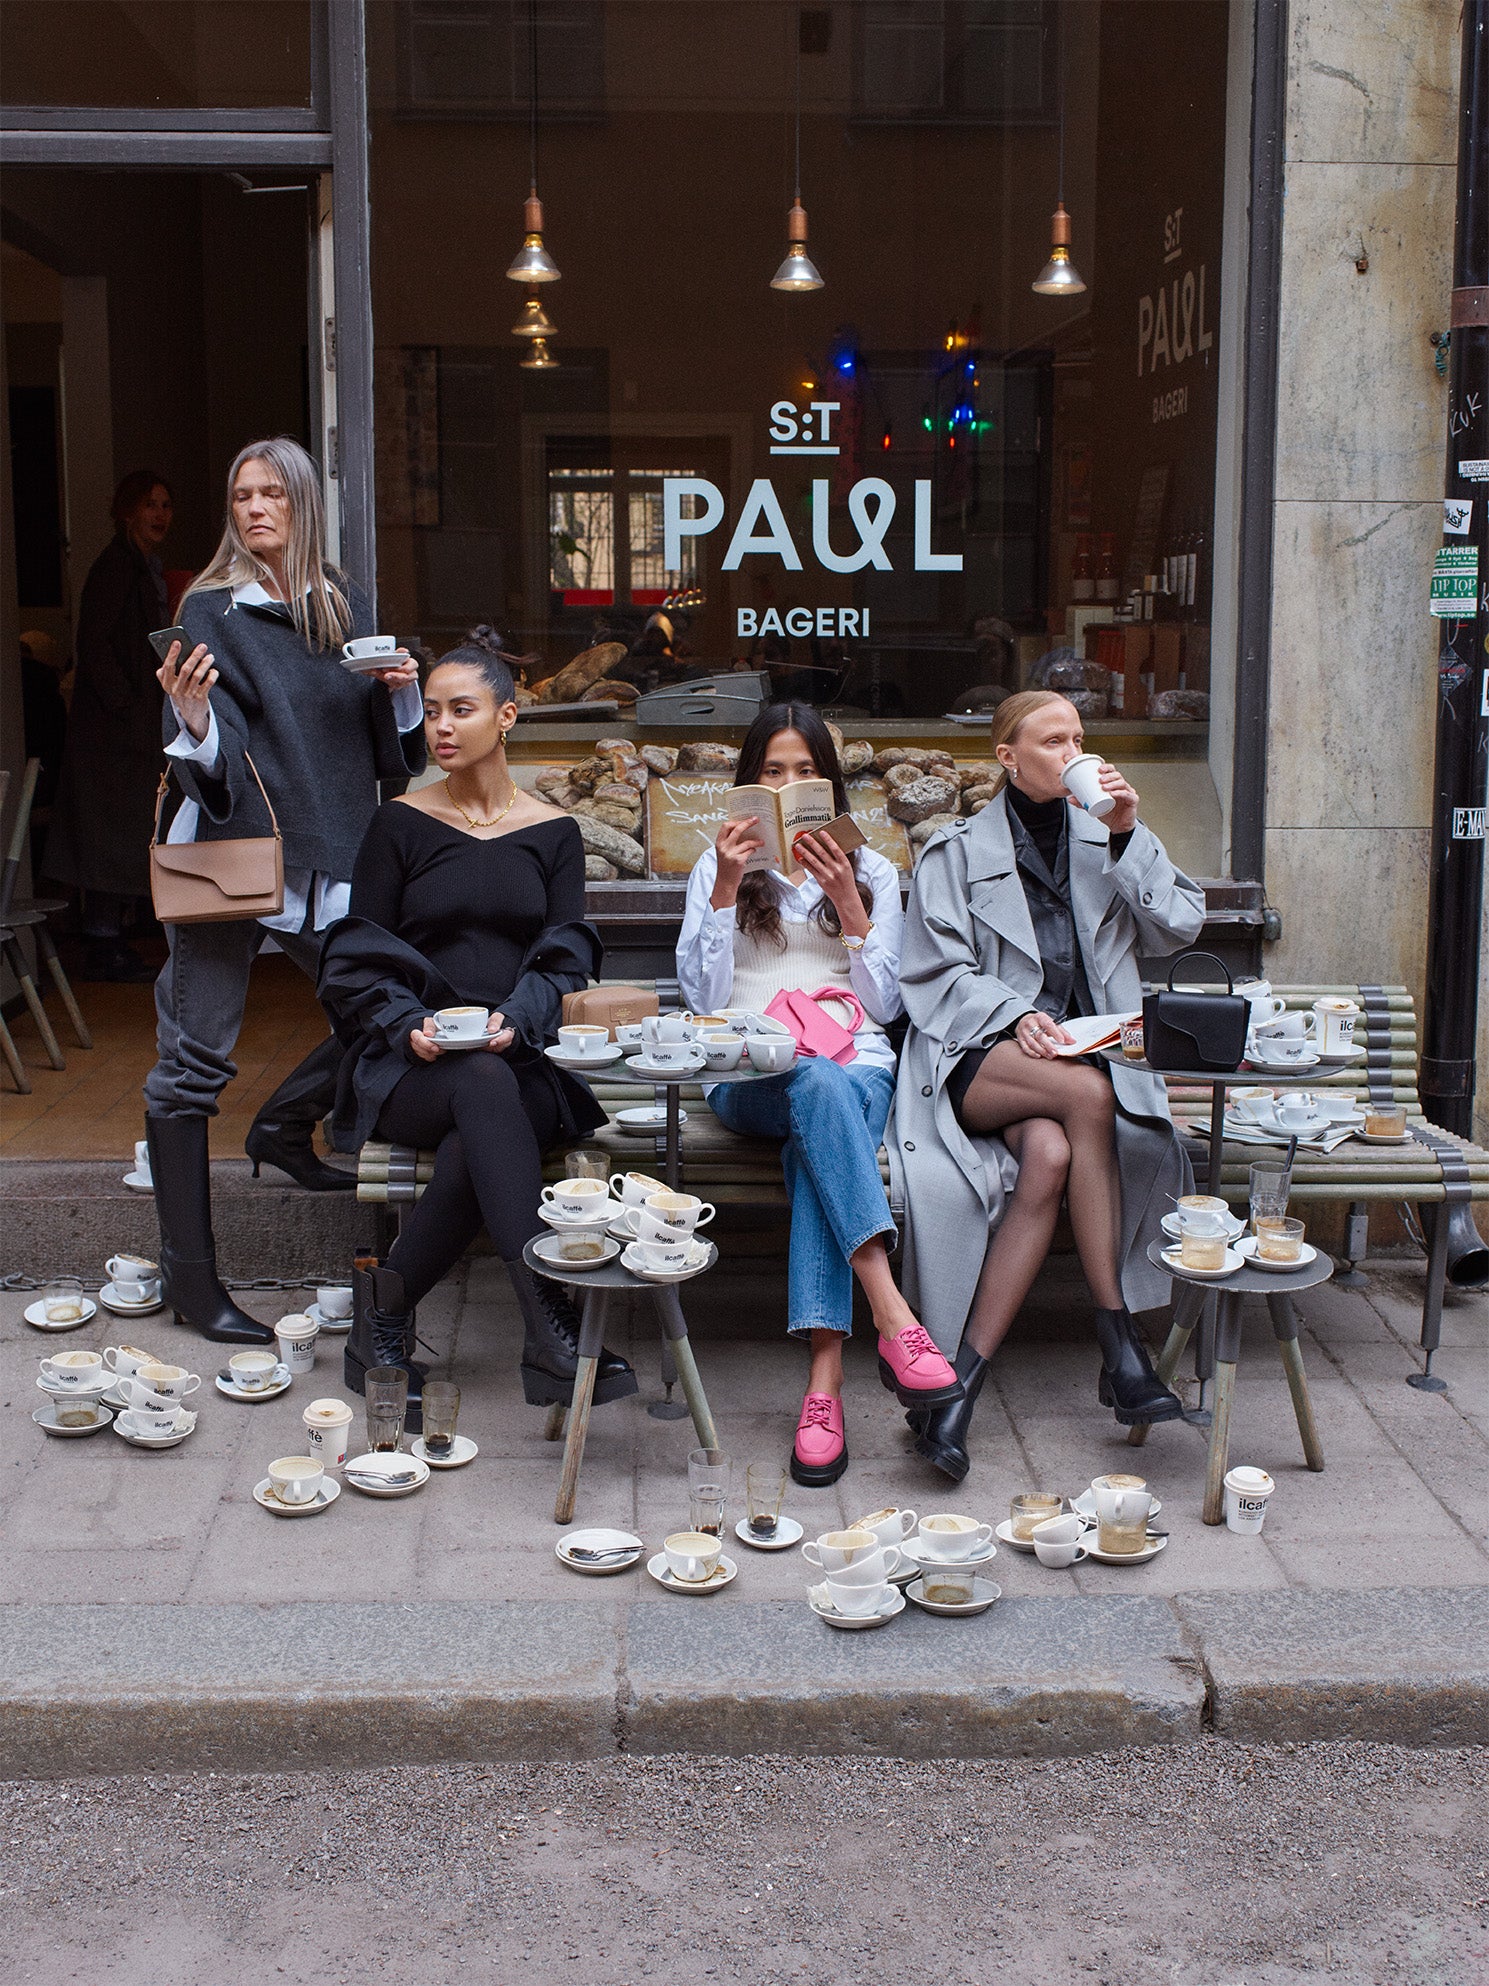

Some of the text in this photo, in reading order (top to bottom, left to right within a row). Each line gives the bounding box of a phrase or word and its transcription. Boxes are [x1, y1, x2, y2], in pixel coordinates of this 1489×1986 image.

[1164, 207, 1183, 252] S:T
[769, 401, 841, 441] S:T
[1152, 386, 1188, 424] BAGERI
[1432, 578, 1477, 592] TIP TOP
[738, 607, 870, 637] BAGERI
[785, 814, 832, 828] Grallimmatik
